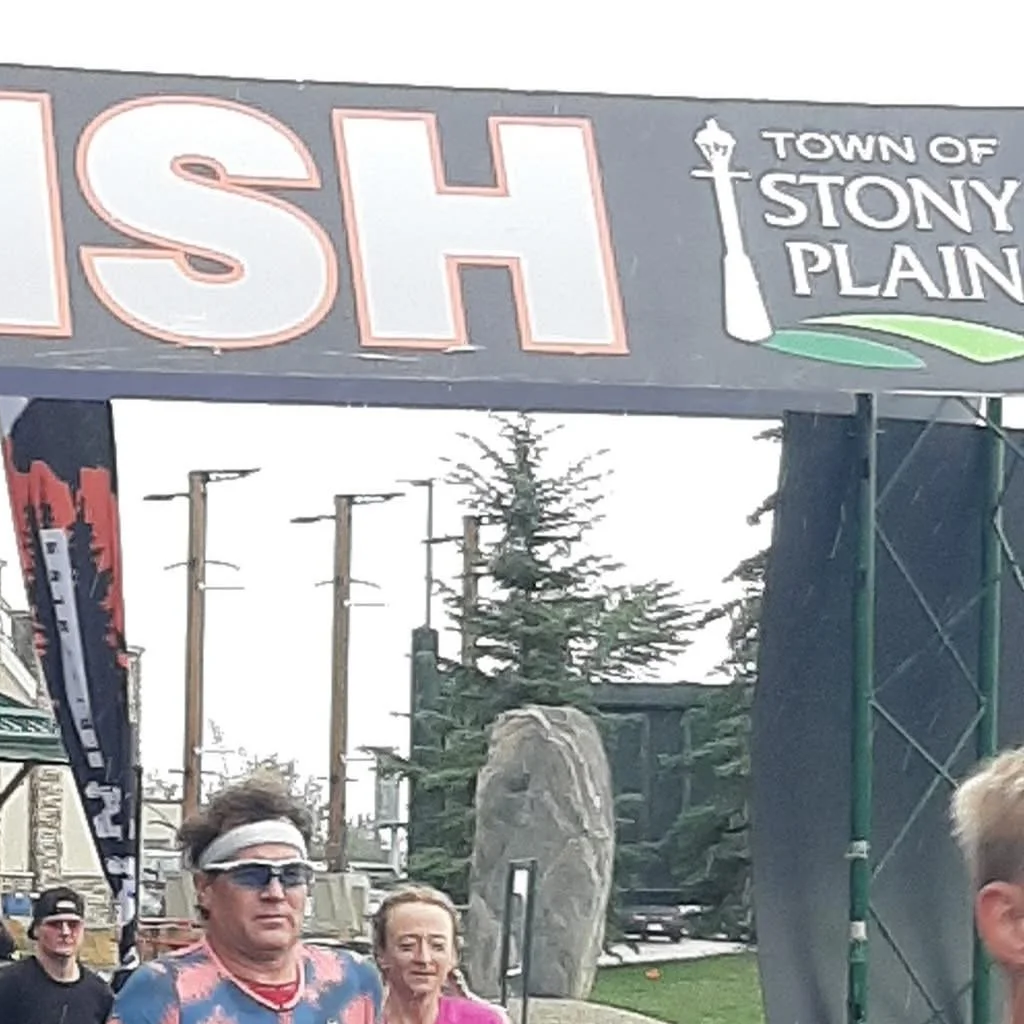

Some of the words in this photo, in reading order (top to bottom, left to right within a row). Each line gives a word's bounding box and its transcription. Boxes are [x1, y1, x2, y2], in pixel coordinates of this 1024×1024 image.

[761, 130, 916, 163] TOWN
[929, 136, 999, 164] OF
[759, 172, 1022, 233] STONY
[785, 240, 1024, 304] PLAIN
